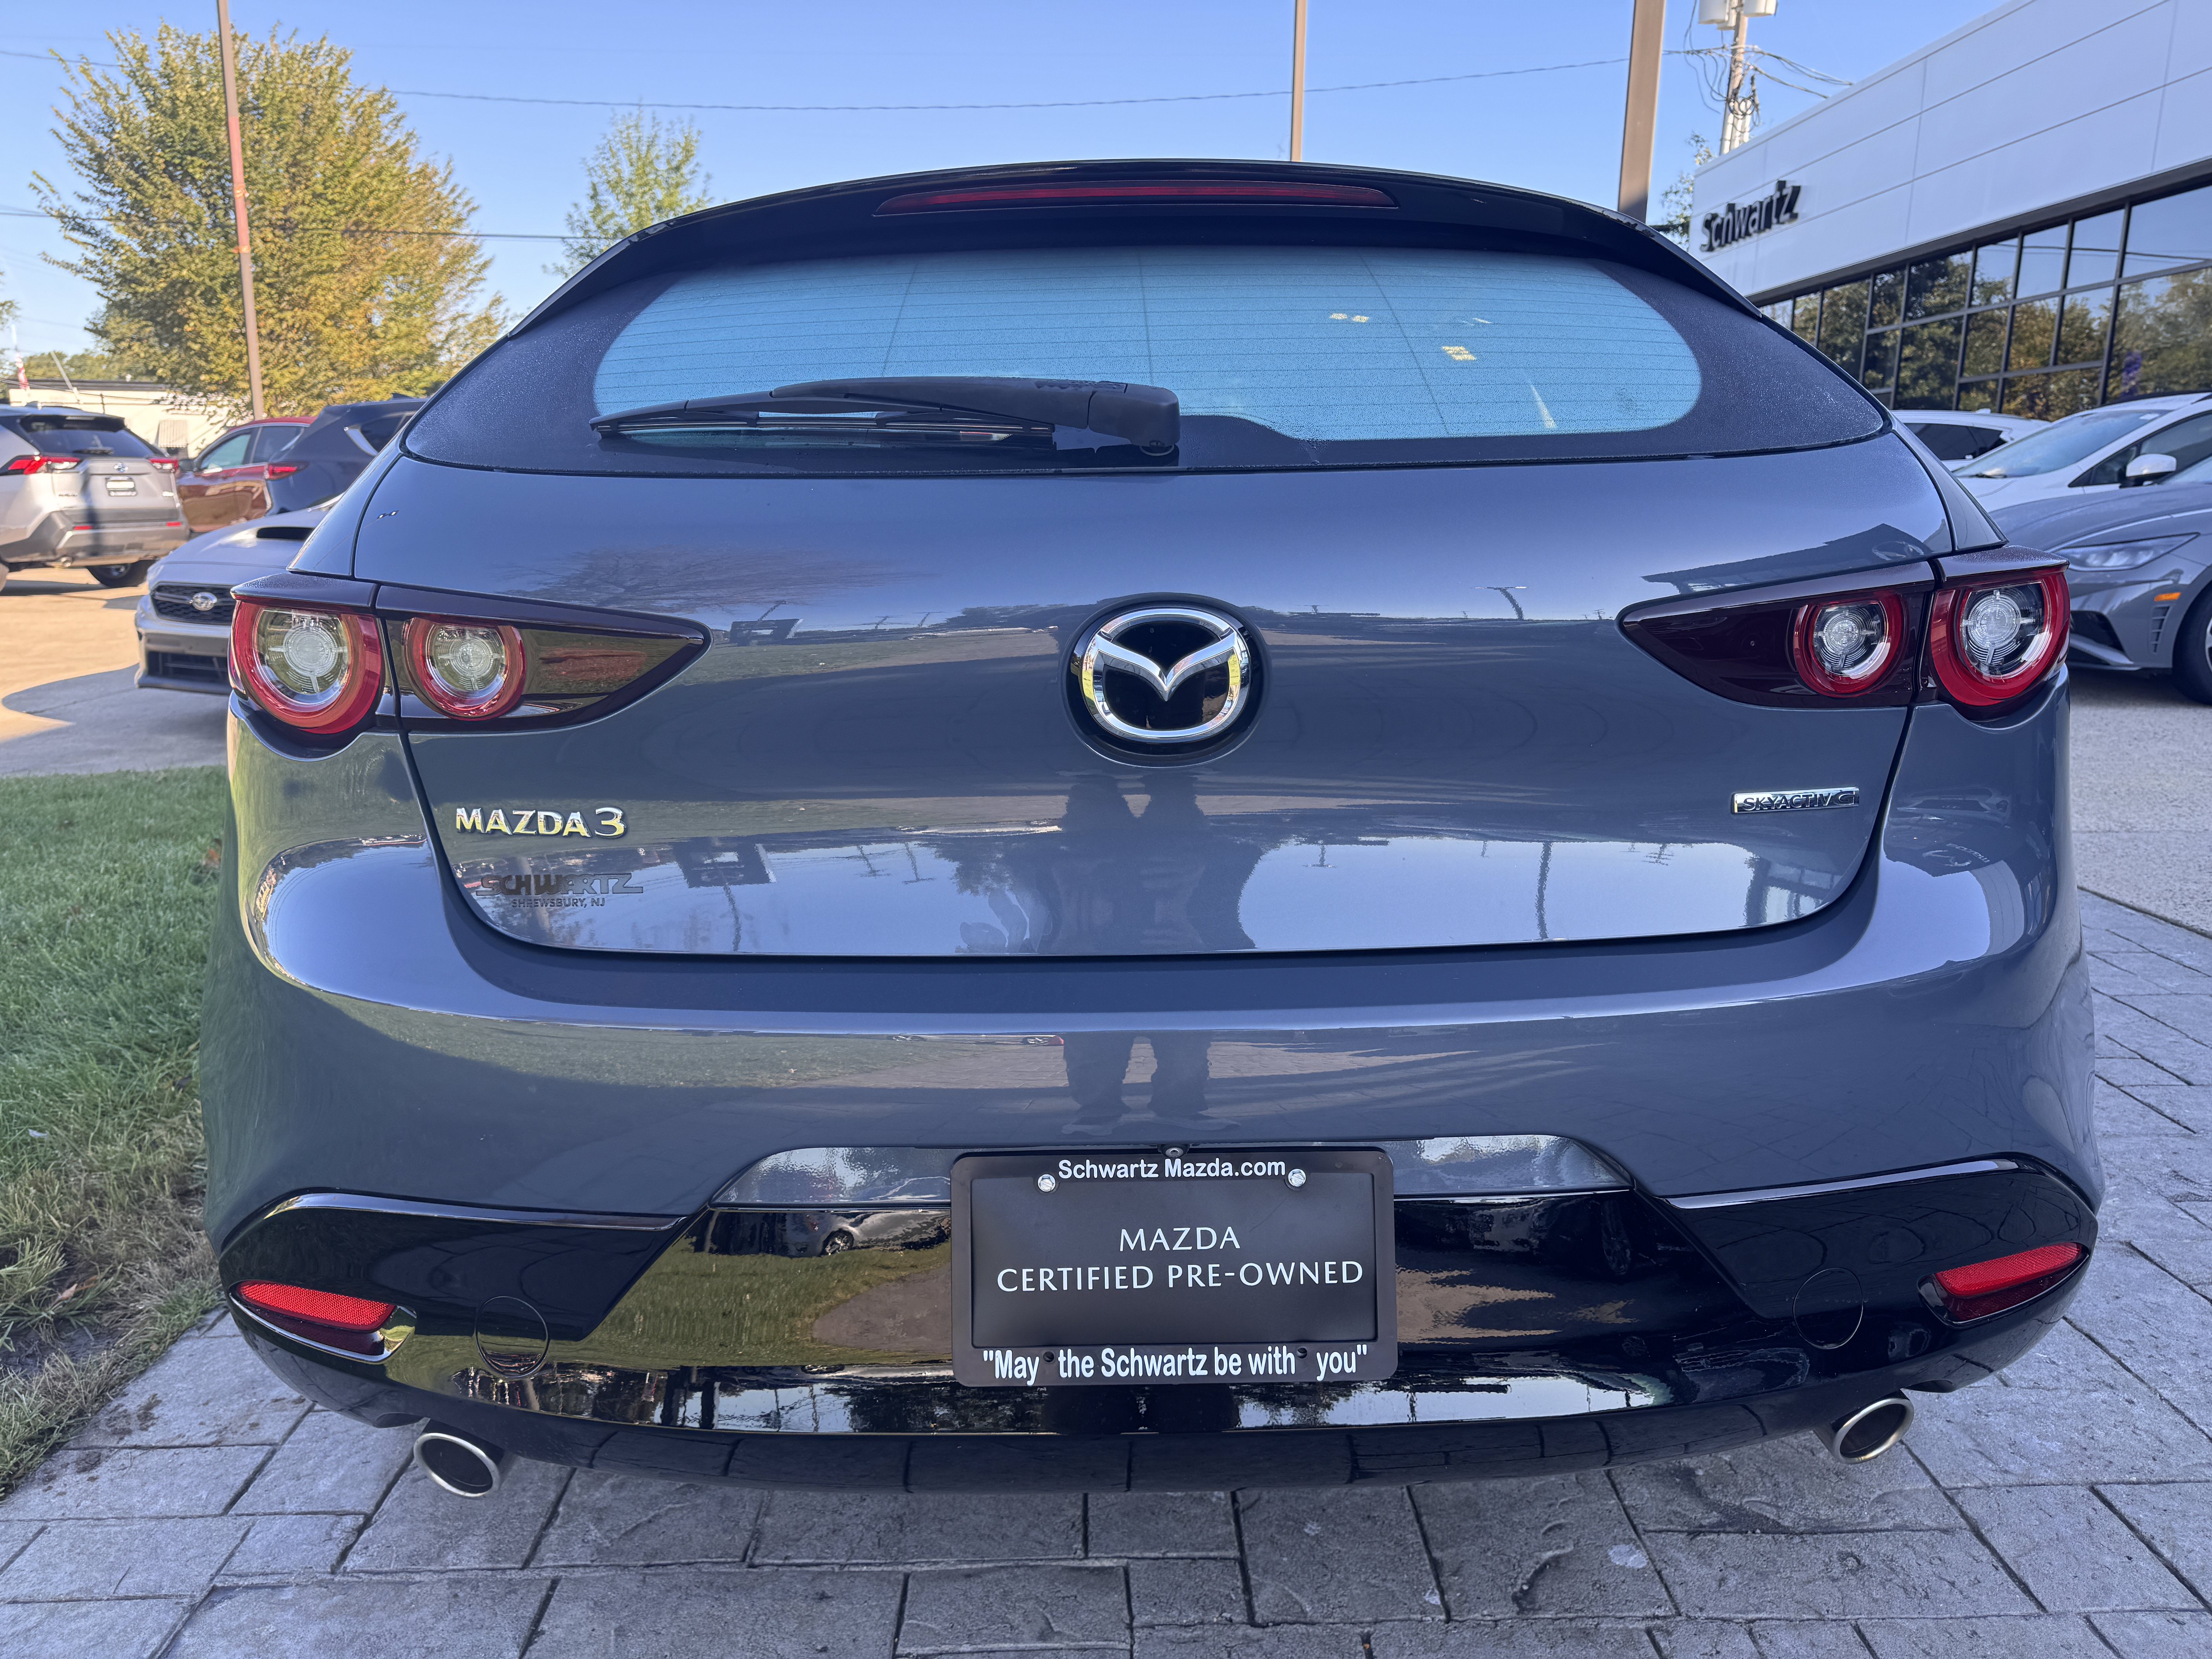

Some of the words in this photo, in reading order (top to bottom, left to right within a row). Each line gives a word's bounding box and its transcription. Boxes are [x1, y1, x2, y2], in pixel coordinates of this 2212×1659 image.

[1700, 180, 1801, 252] Schwartz
[475, 873, 643, 896] SCHWARTZ
[512, 898, 587, 908] SHREWSBURY,
[591, 898, 605, 907] NJ
[1058, 1159, 1158, 1179] Schwartz
[1165, 1158, 1285, 1177] Mazda.com
[1120, 1226, 1241, 1252] MAZDA
[997, 1266, 1154, 1292] CERTIFIED
[1168, 1261, 1363, 1288] PRE-OWNED
[983, 1350, 1039, 1386] "May
[1058, 1348, 1094, 1378] the
[1101, 1347, 1208, 1377] Schwartz
[1214, 1346, 1242, 1376] be
[1248, 1345, 1295, 1375] with
[1316, 1344, 1368, 1381] you"
